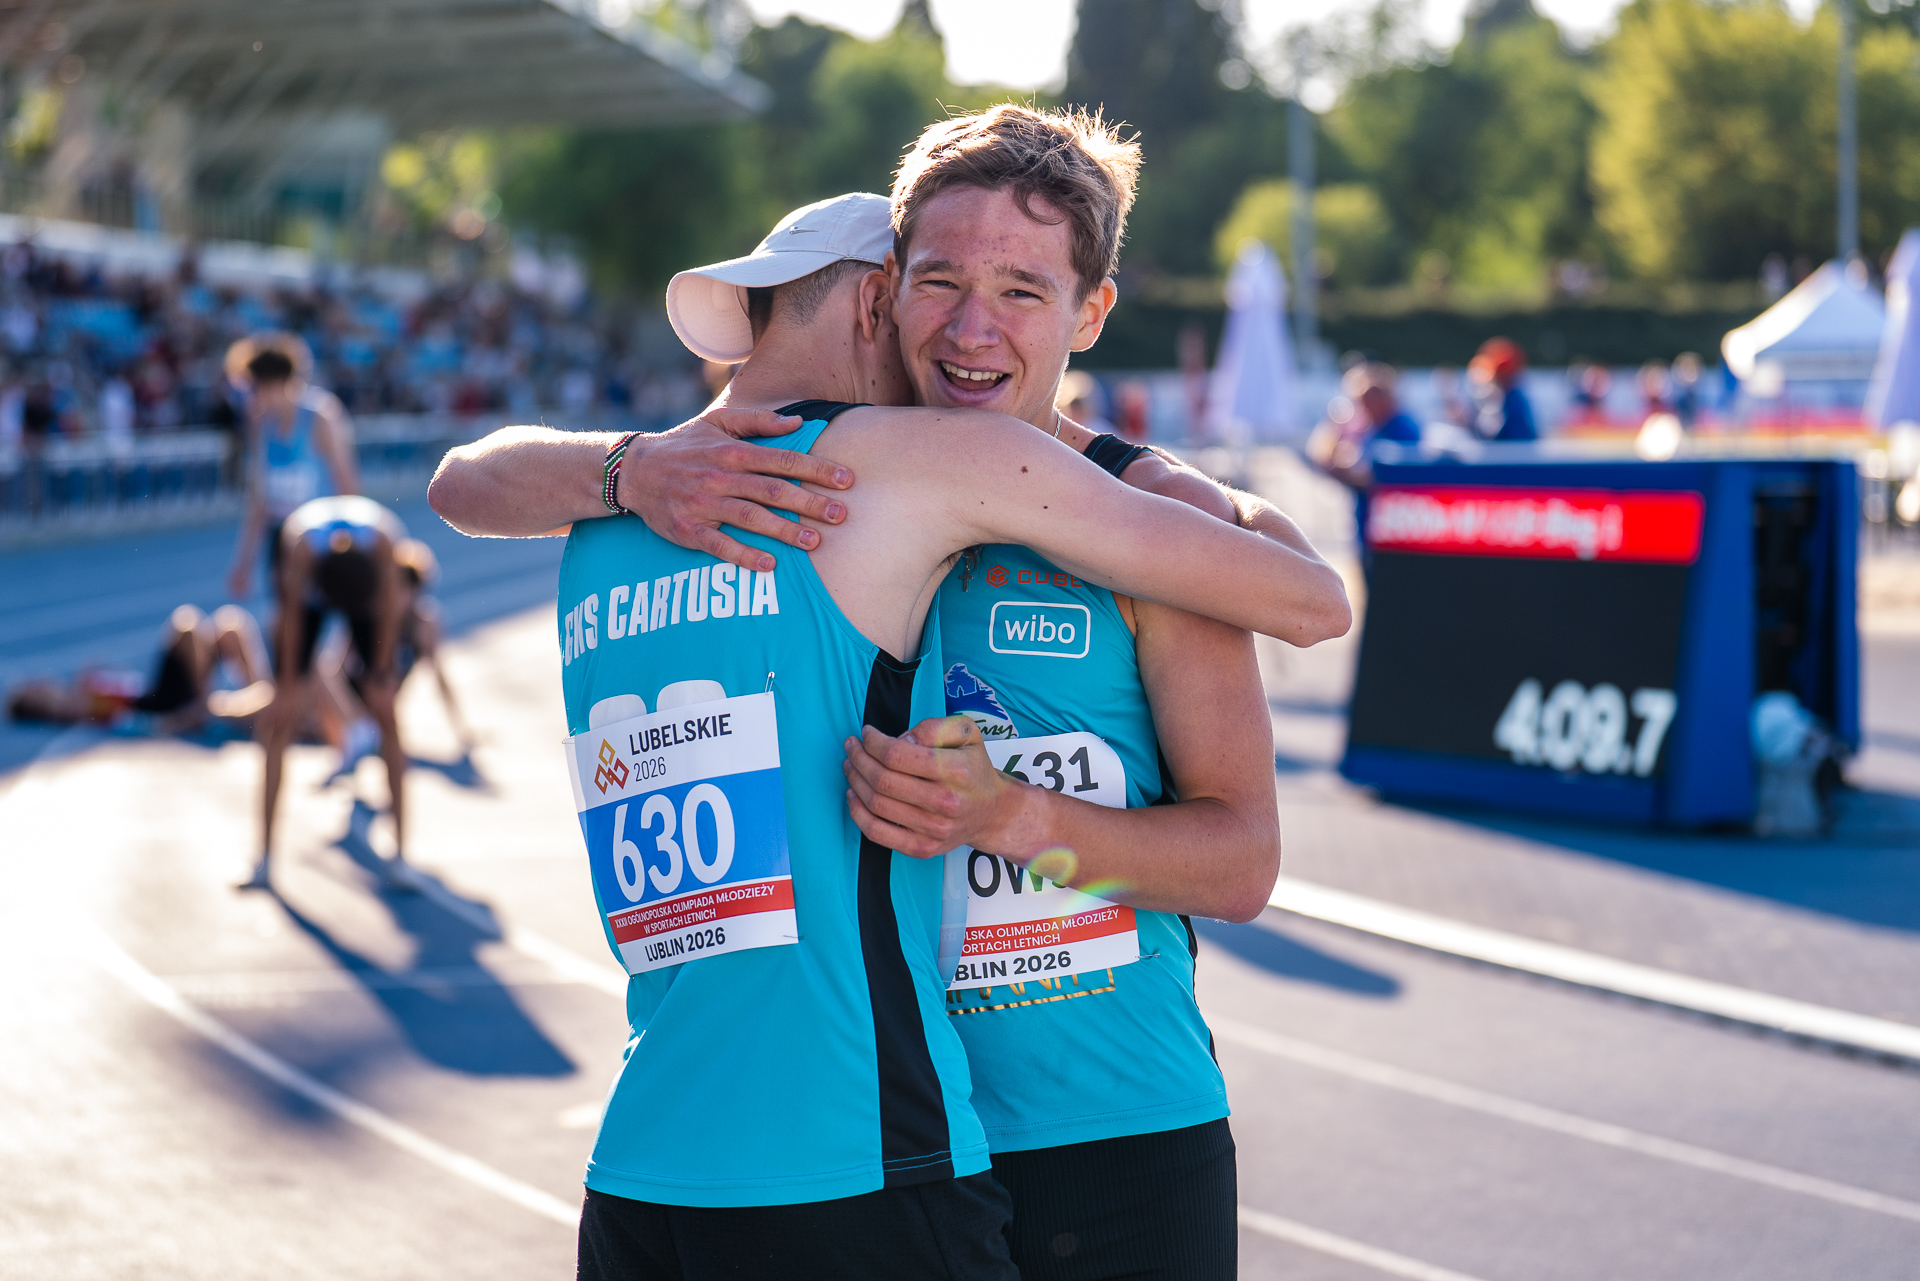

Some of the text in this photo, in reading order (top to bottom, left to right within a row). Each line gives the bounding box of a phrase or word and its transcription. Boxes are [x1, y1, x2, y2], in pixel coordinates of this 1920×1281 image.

[607, 562, 780, 640] CARTUSIA
[1005, 614, 1076, 644] wibo
[629, 713, 733, 756] LUBELSKIE
[633, 756, 667, 783] 2026
[612, 783, 736, 903] 630
[628, 905, 673, 926] OGÓLNOPOLSKA
[672, 896, 715, 912] OLIMPIADA
[716, 884, 775, 903] MŁODZIEŻY
[643, 908, 717, 935] W SPORTACH LETNICH
[964, 929, 994, 941] LSKA
[996, 920, 1060, 938] OLIMPIADA
[1062, 908, 1120, 930] MŁODZIEŻY
[1014, 933, 1061, 949] LETNICH
[645, 926, 726, 962] LUBLIN 2026
[1013, 950, 1072, 975] 2026
